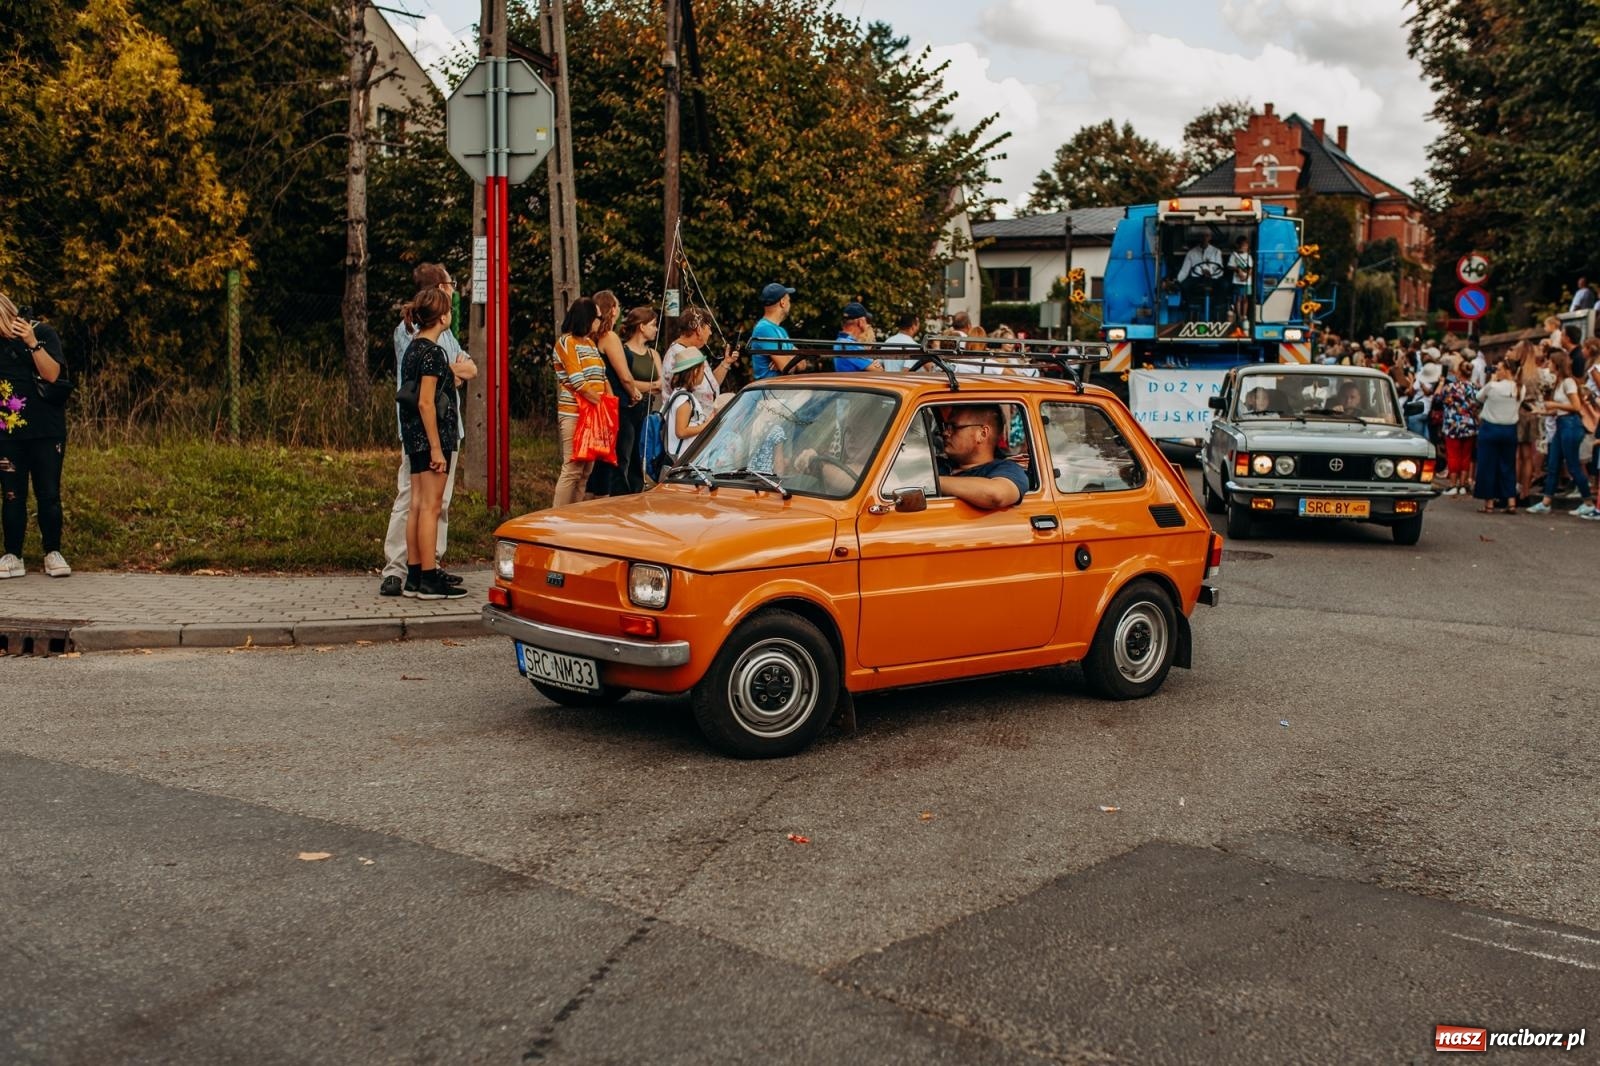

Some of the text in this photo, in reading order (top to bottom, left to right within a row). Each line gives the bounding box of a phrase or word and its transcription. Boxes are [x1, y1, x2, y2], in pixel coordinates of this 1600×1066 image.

[1462, 262, 1487, 278] 40
[1307, 501, 1351, 514] SRC 8Y
[525, 647, 551, 677] SRC
[553, 655, 594, 687] NM33
